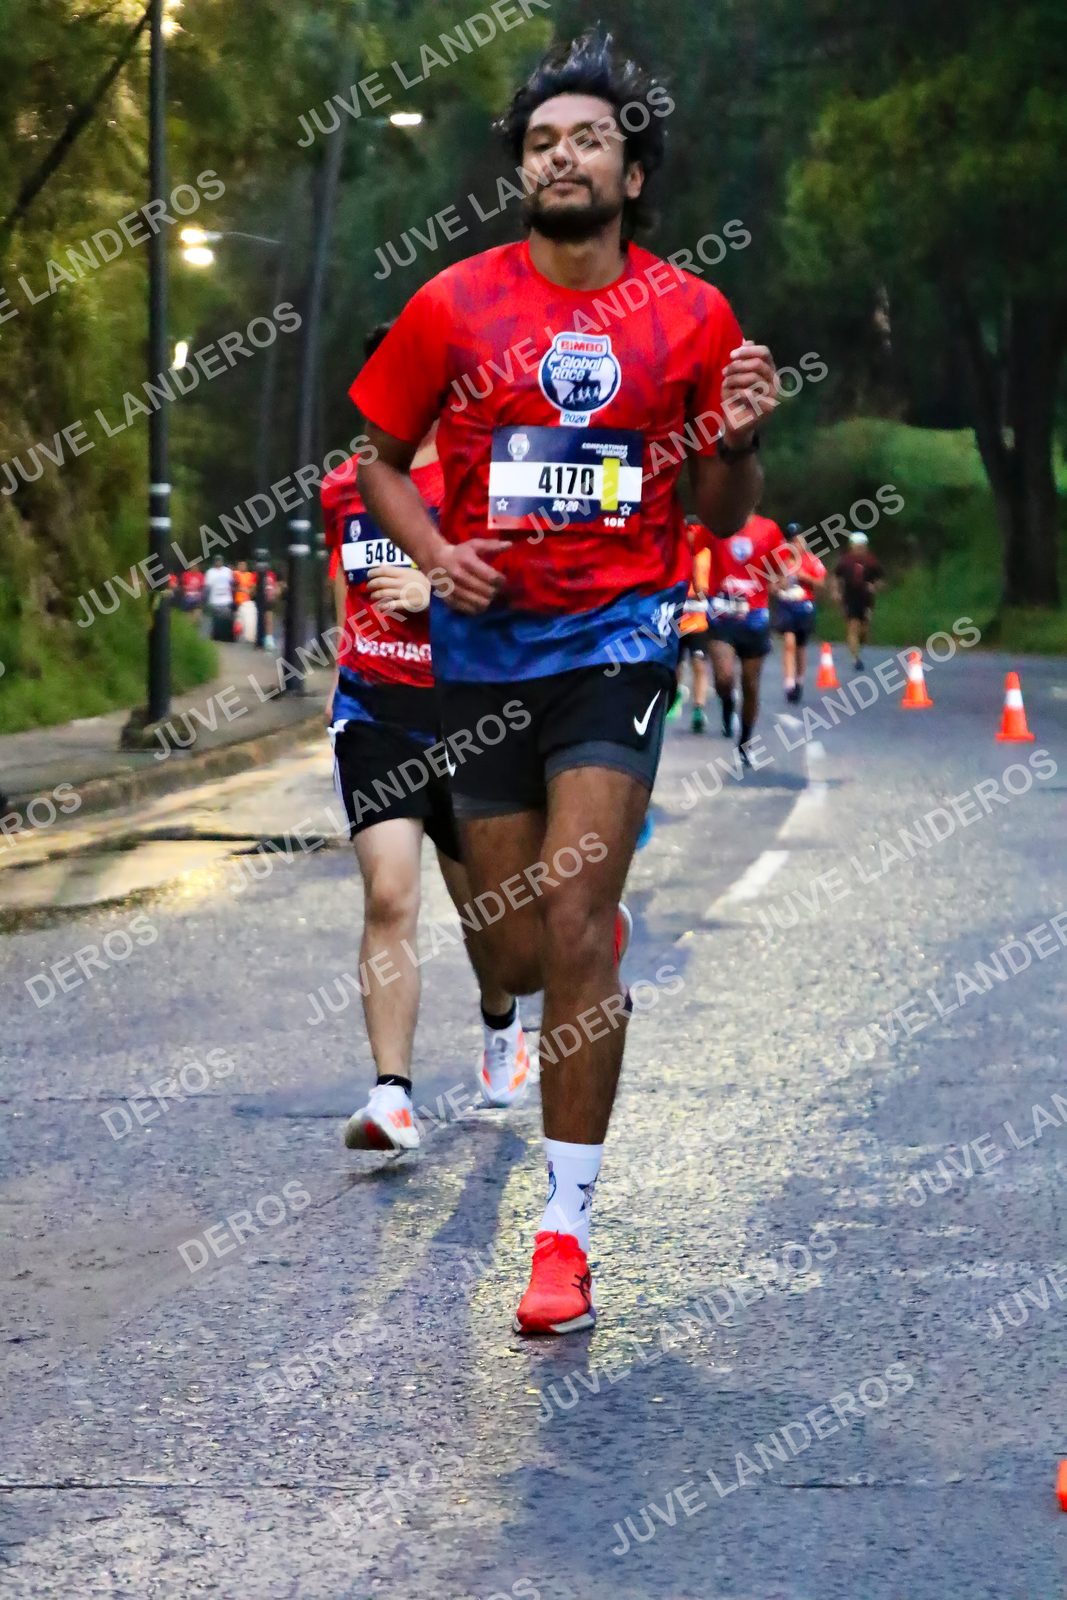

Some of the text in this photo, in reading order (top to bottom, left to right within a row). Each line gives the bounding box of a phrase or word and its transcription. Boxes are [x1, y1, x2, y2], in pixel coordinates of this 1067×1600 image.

[561, 341, 603, 352] BIMBO
[560, 355, 602, 371] Global
[551, 366, 586, 381] Race
[538, 466, 594, 496] 4170
[603, 517, 626, 528] 10K
